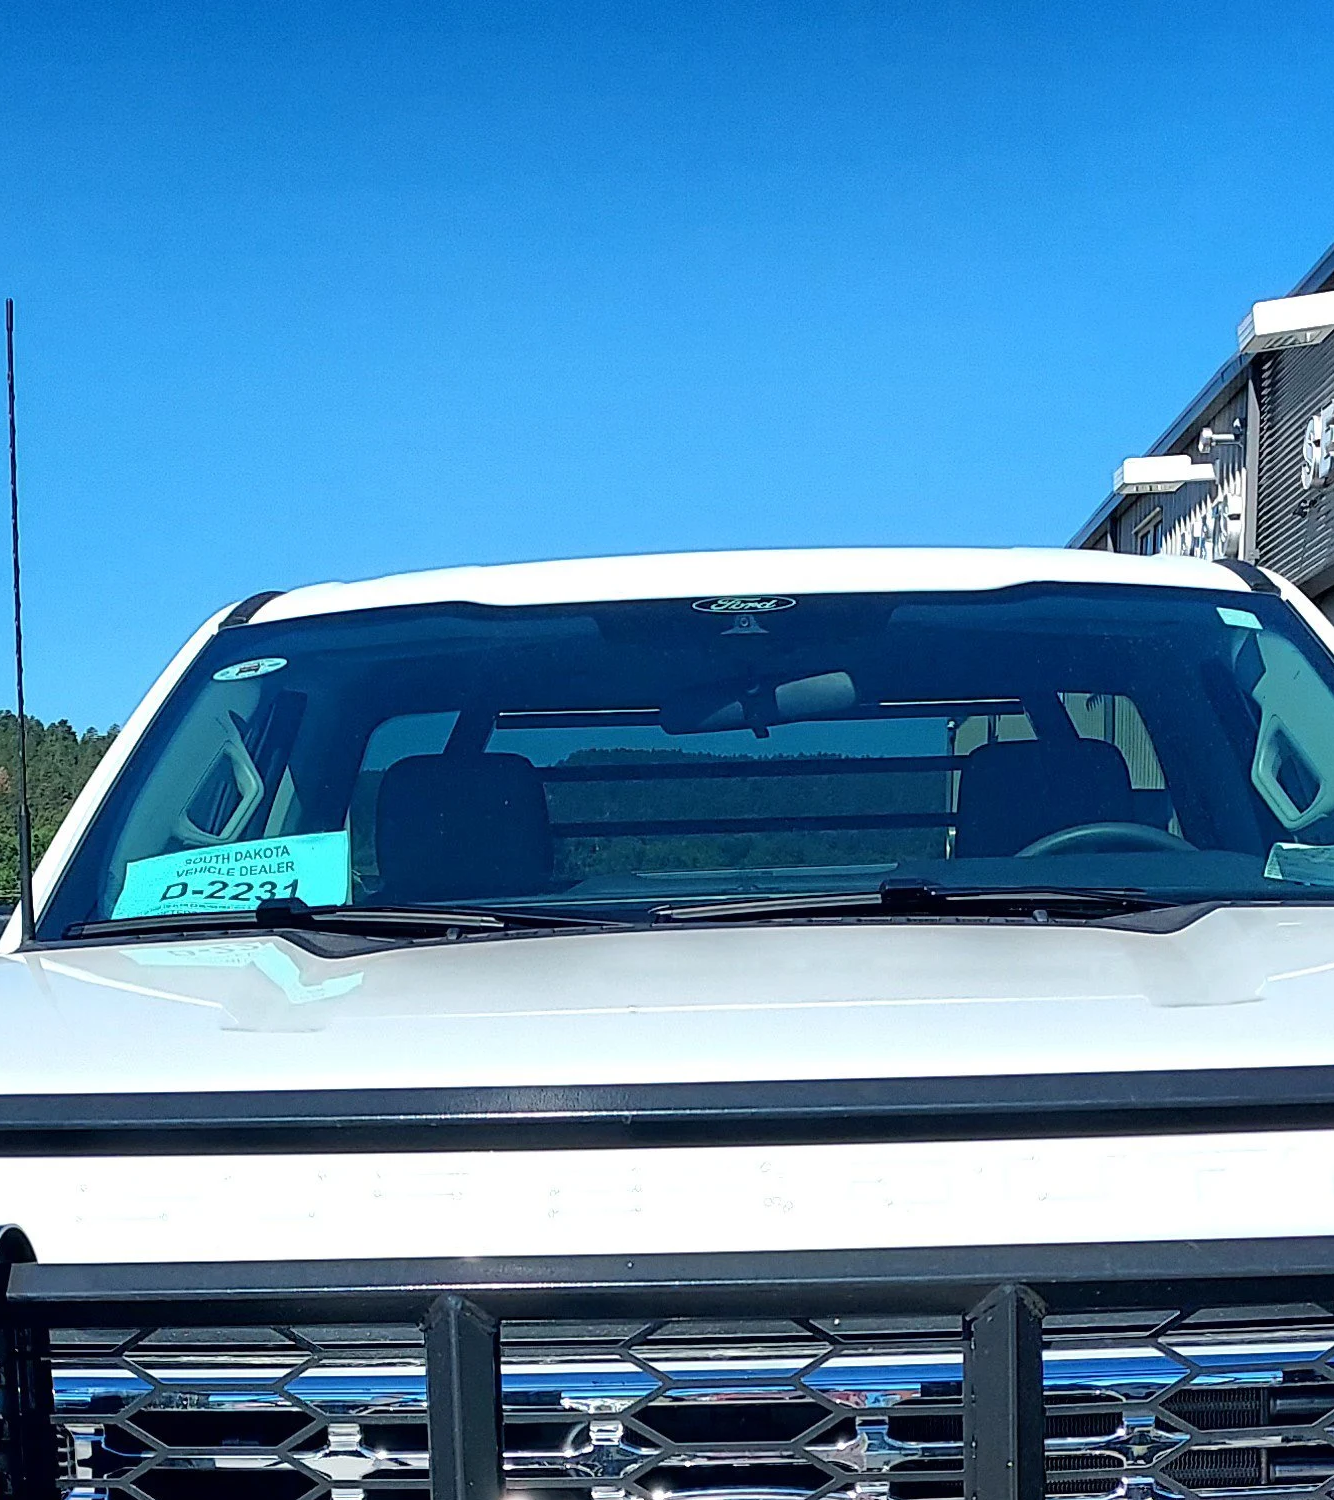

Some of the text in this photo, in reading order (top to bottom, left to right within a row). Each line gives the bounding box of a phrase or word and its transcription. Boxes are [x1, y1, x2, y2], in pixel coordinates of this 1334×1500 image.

[710, 597, 778, 610] Ford
[185, 845, 290, 866] SOUTH DAKOTA
[176, 861, 295, 878] VEHICLE DEALER
[159, 878, 299, 903] D-2231
